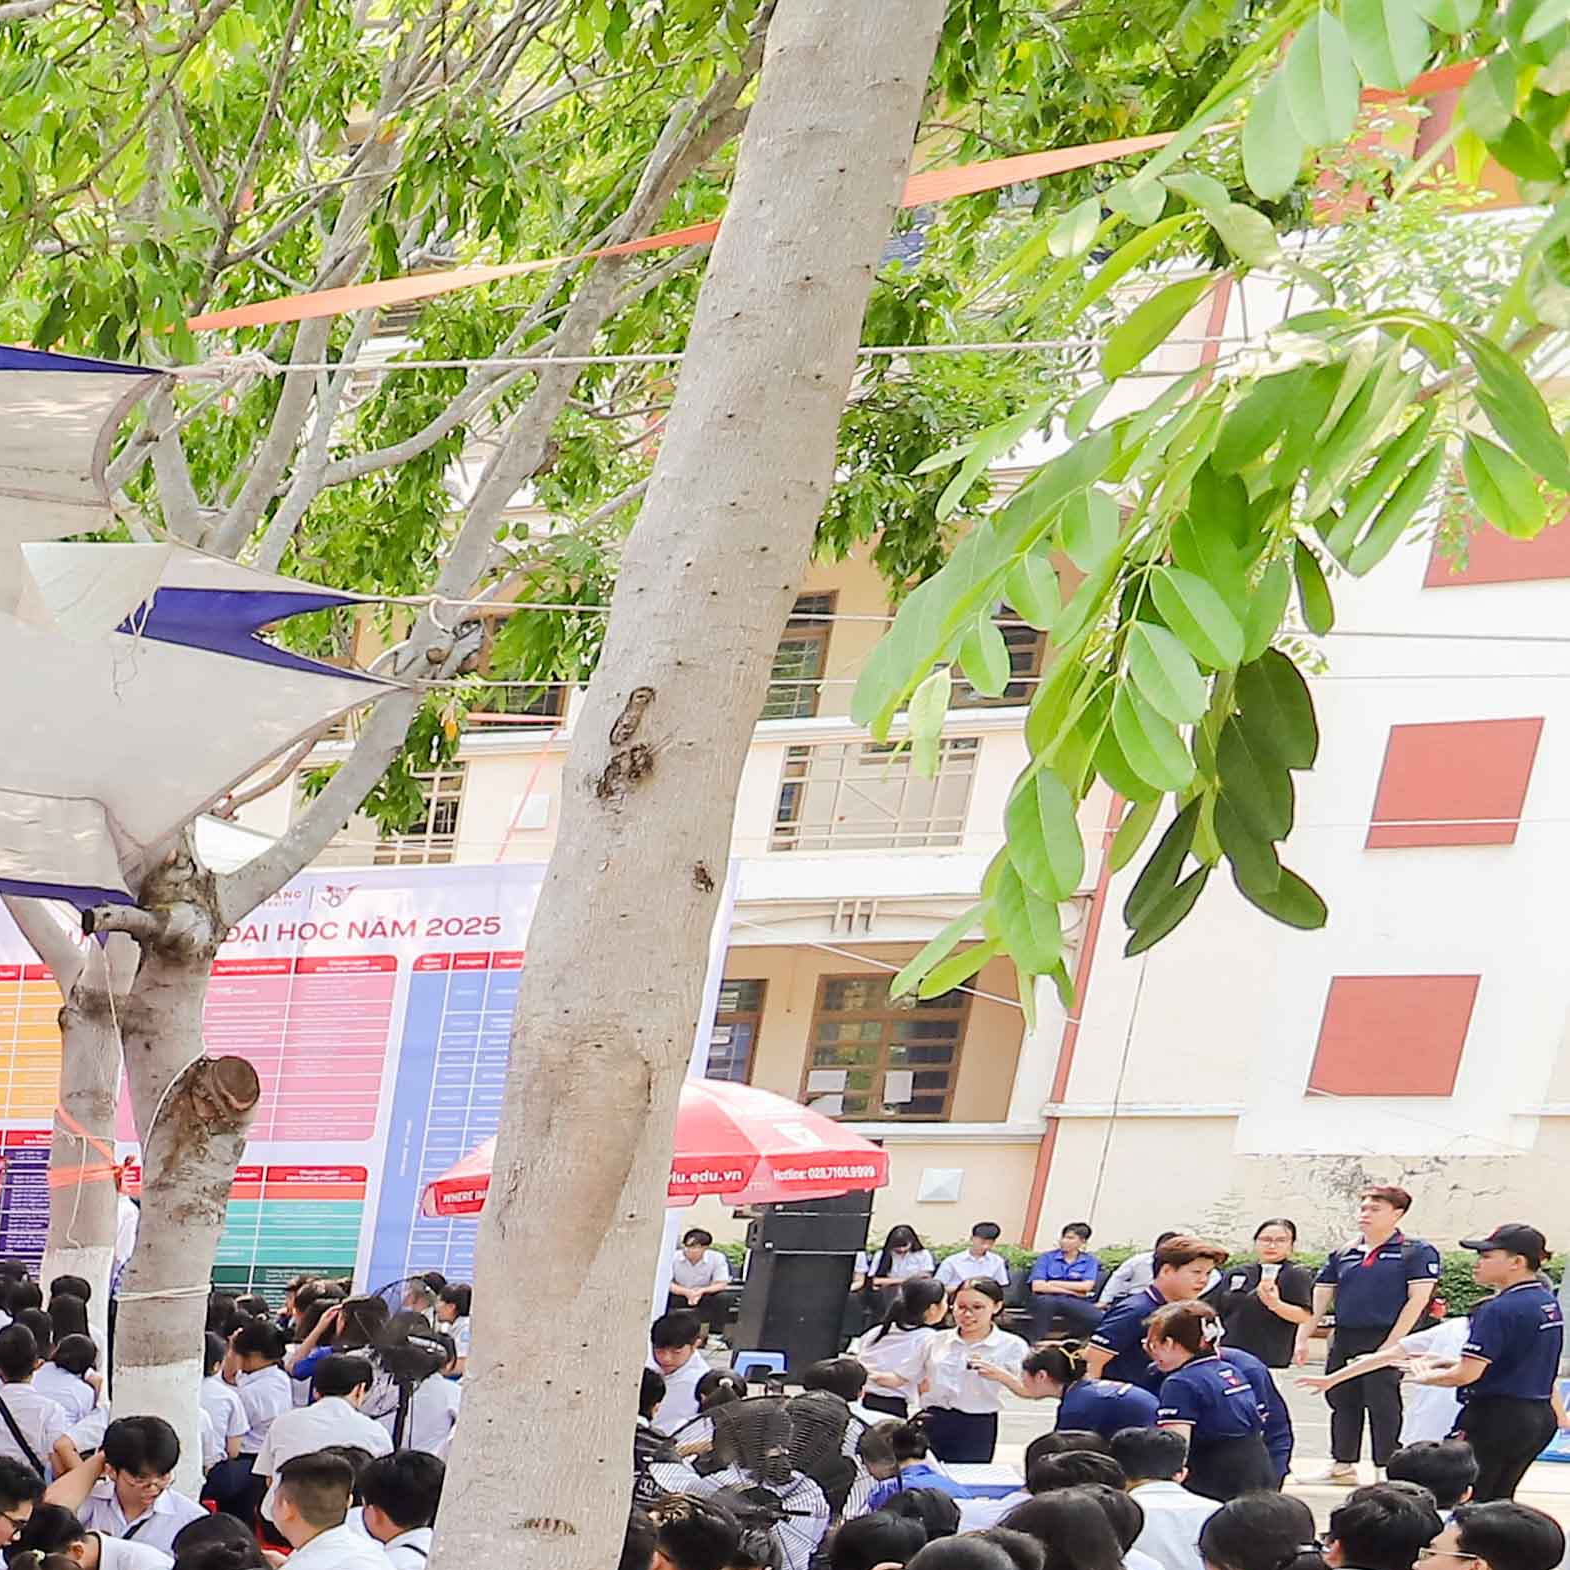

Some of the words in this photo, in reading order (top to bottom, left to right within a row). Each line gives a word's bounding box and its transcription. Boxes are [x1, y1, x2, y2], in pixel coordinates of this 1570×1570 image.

[276, 921, 339, 946] HỌC
[346, 914, 417, 939] NĂM
[425, 916, 502, 937] 2025
[669, 1170, 743, 1184] lu.edu.vn
